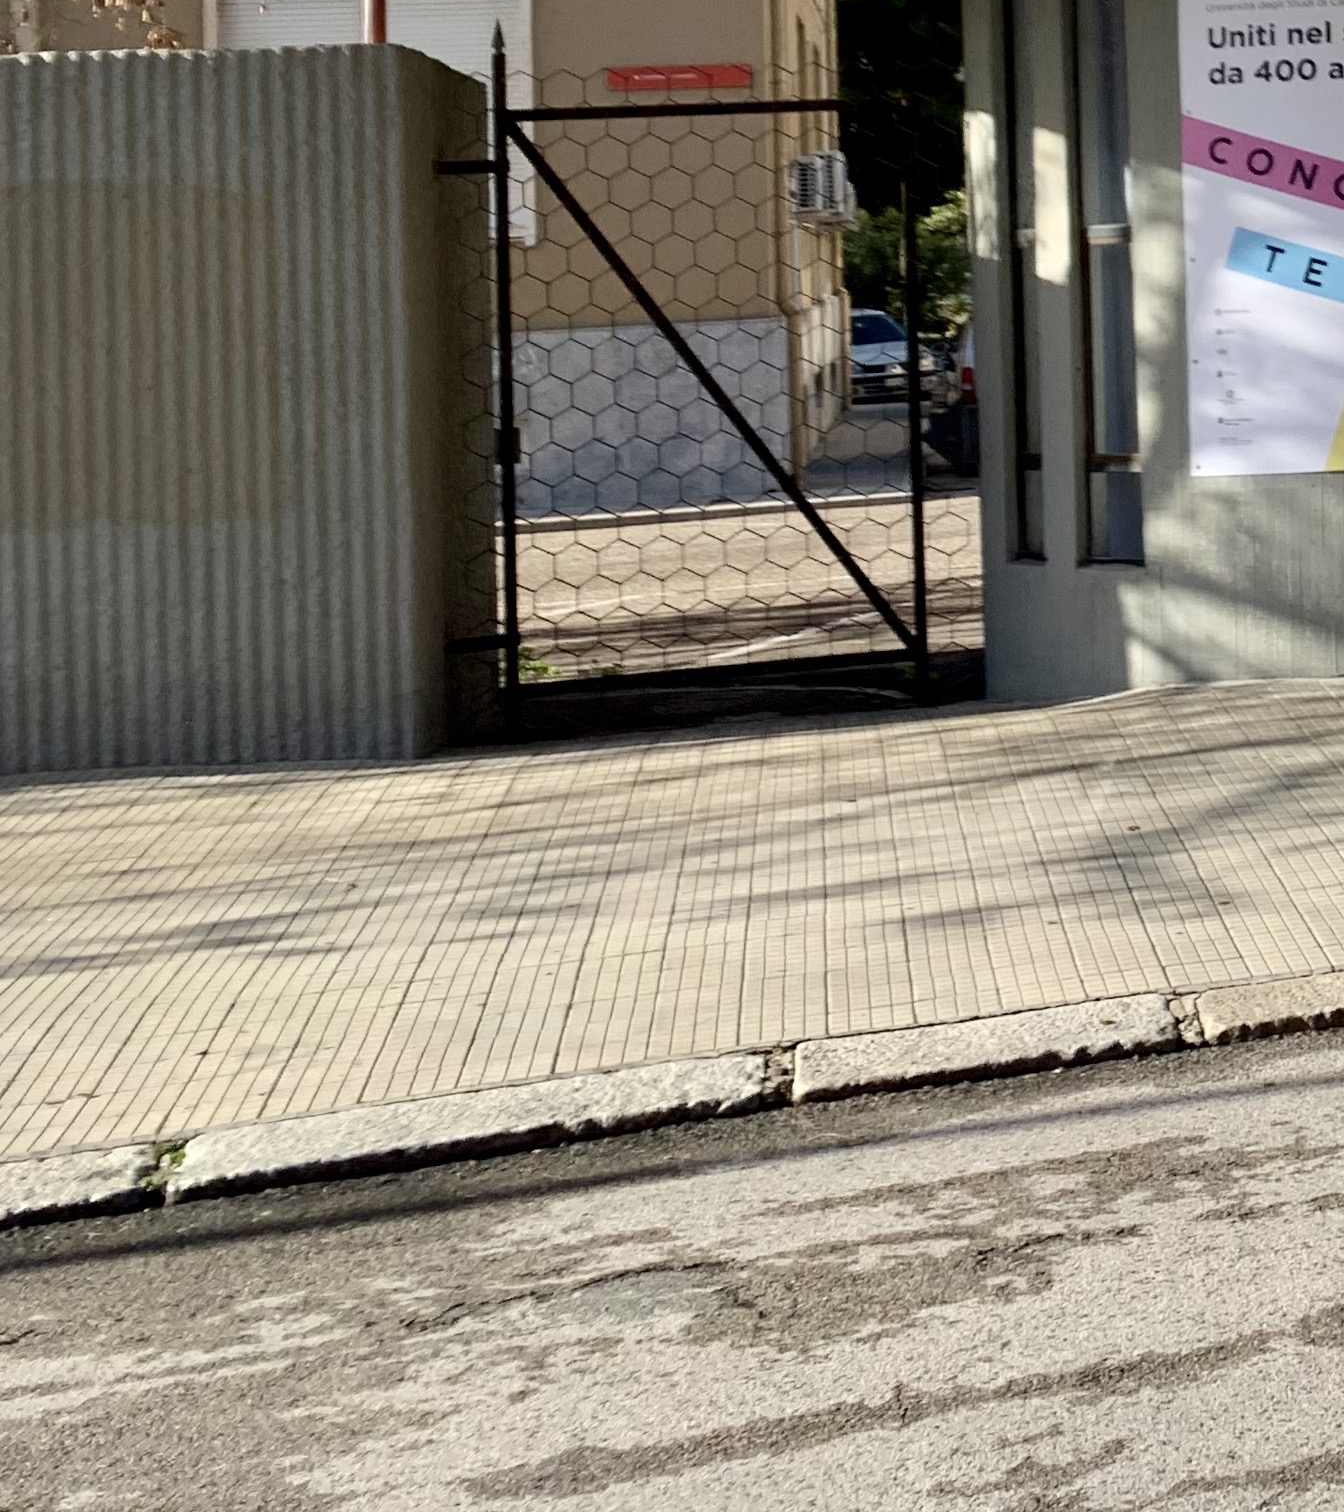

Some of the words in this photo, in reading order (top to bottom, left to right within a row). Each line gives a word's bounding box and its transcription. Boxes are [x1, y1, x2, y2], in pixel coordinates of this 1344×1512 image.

[1207, 22, 1277, 49] Uniti
[1287, 20, 1332, 45] nel
[1208, 61, 1244, 86] da
[1253, 57, 1318, 83] 400
